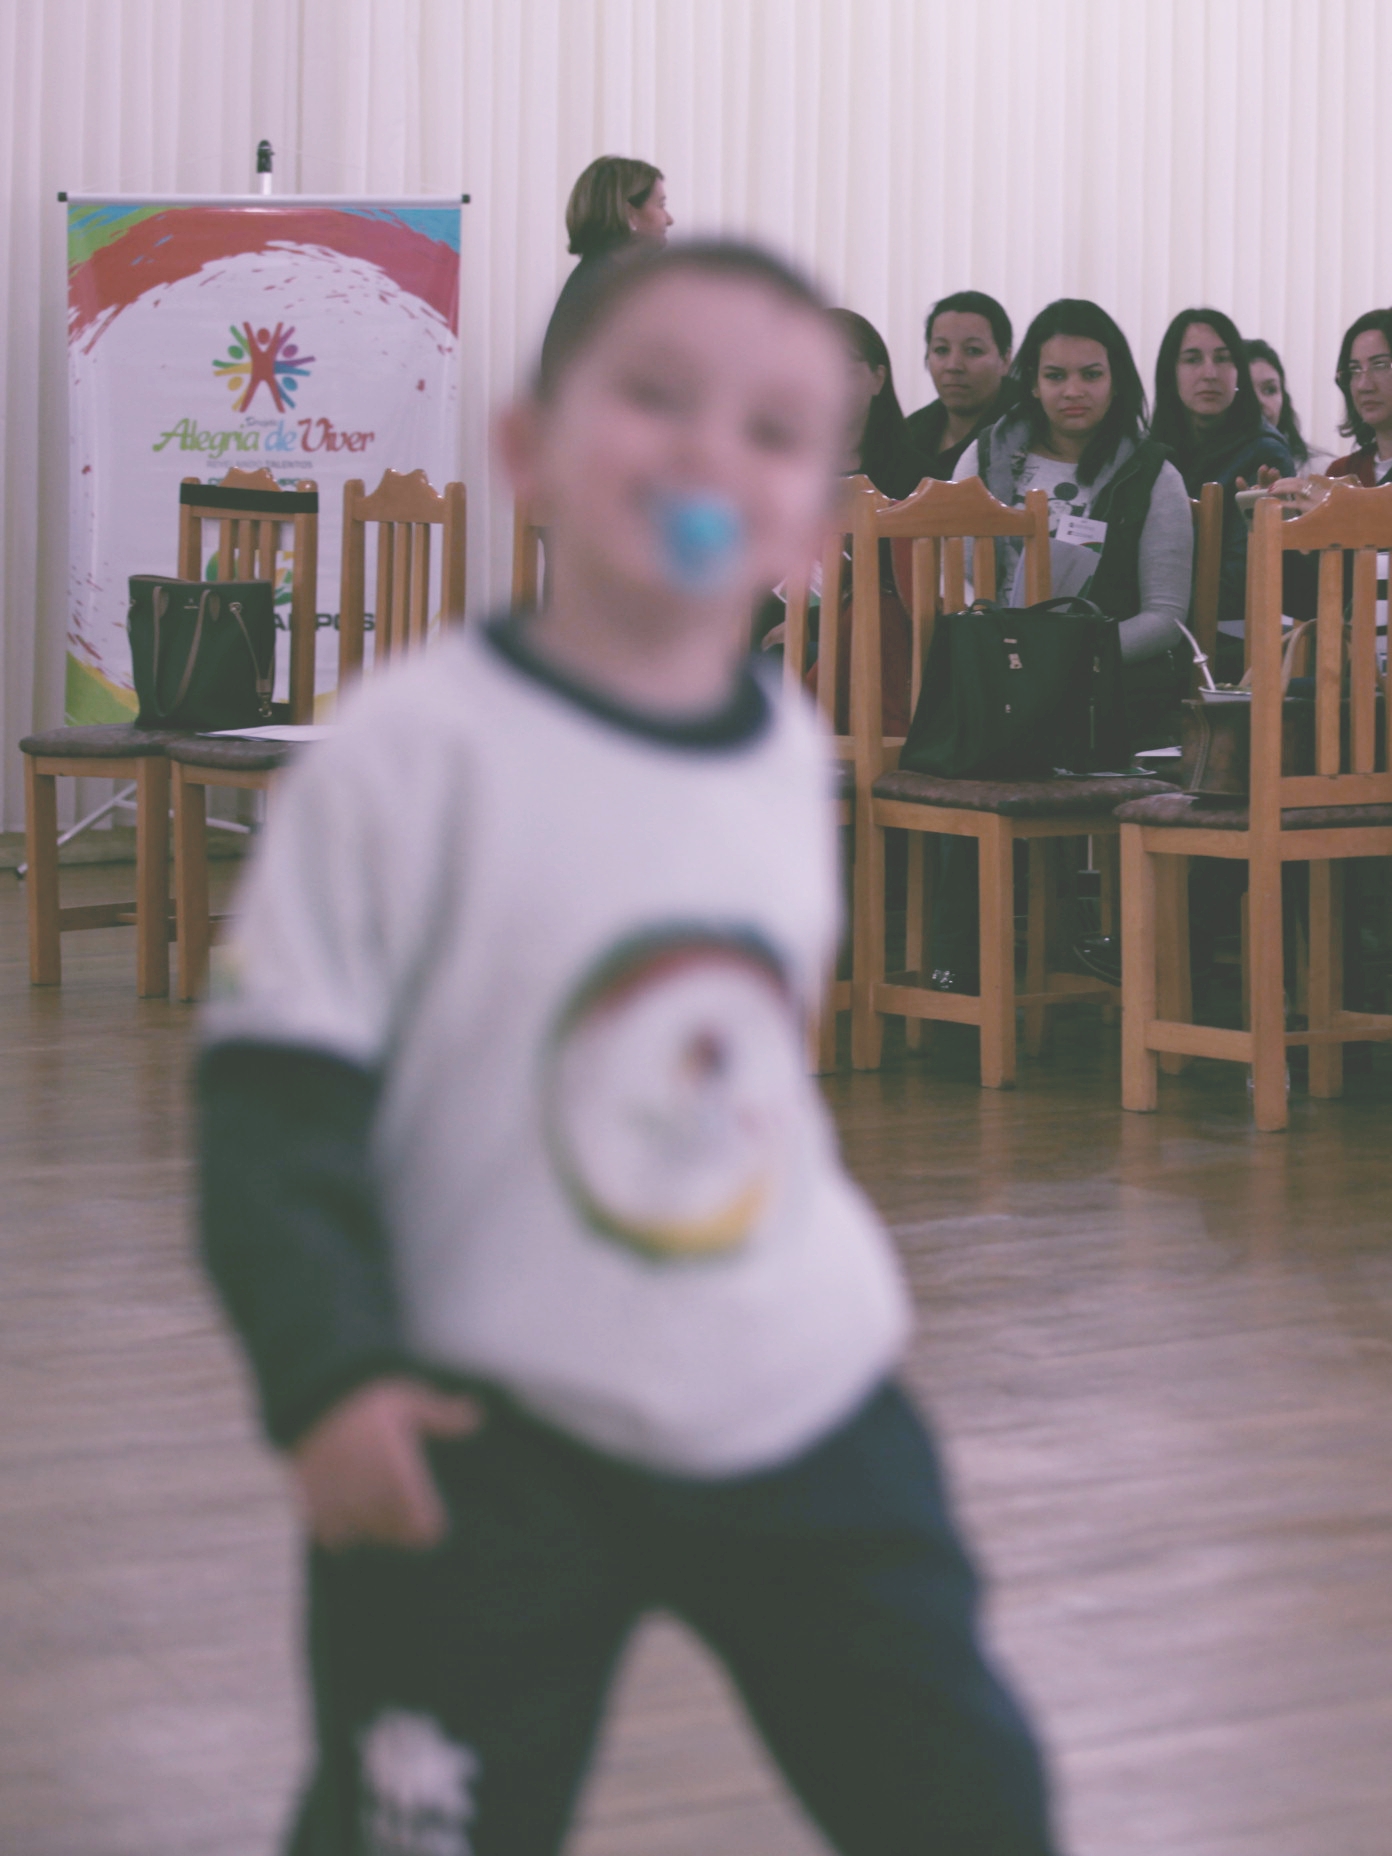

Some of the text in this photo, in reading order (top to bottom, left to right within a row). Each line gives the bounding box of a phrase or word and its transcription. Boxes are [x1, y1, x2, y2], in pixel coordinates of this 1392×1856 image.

[152, 417, 375, 459] Alegria de Viver
